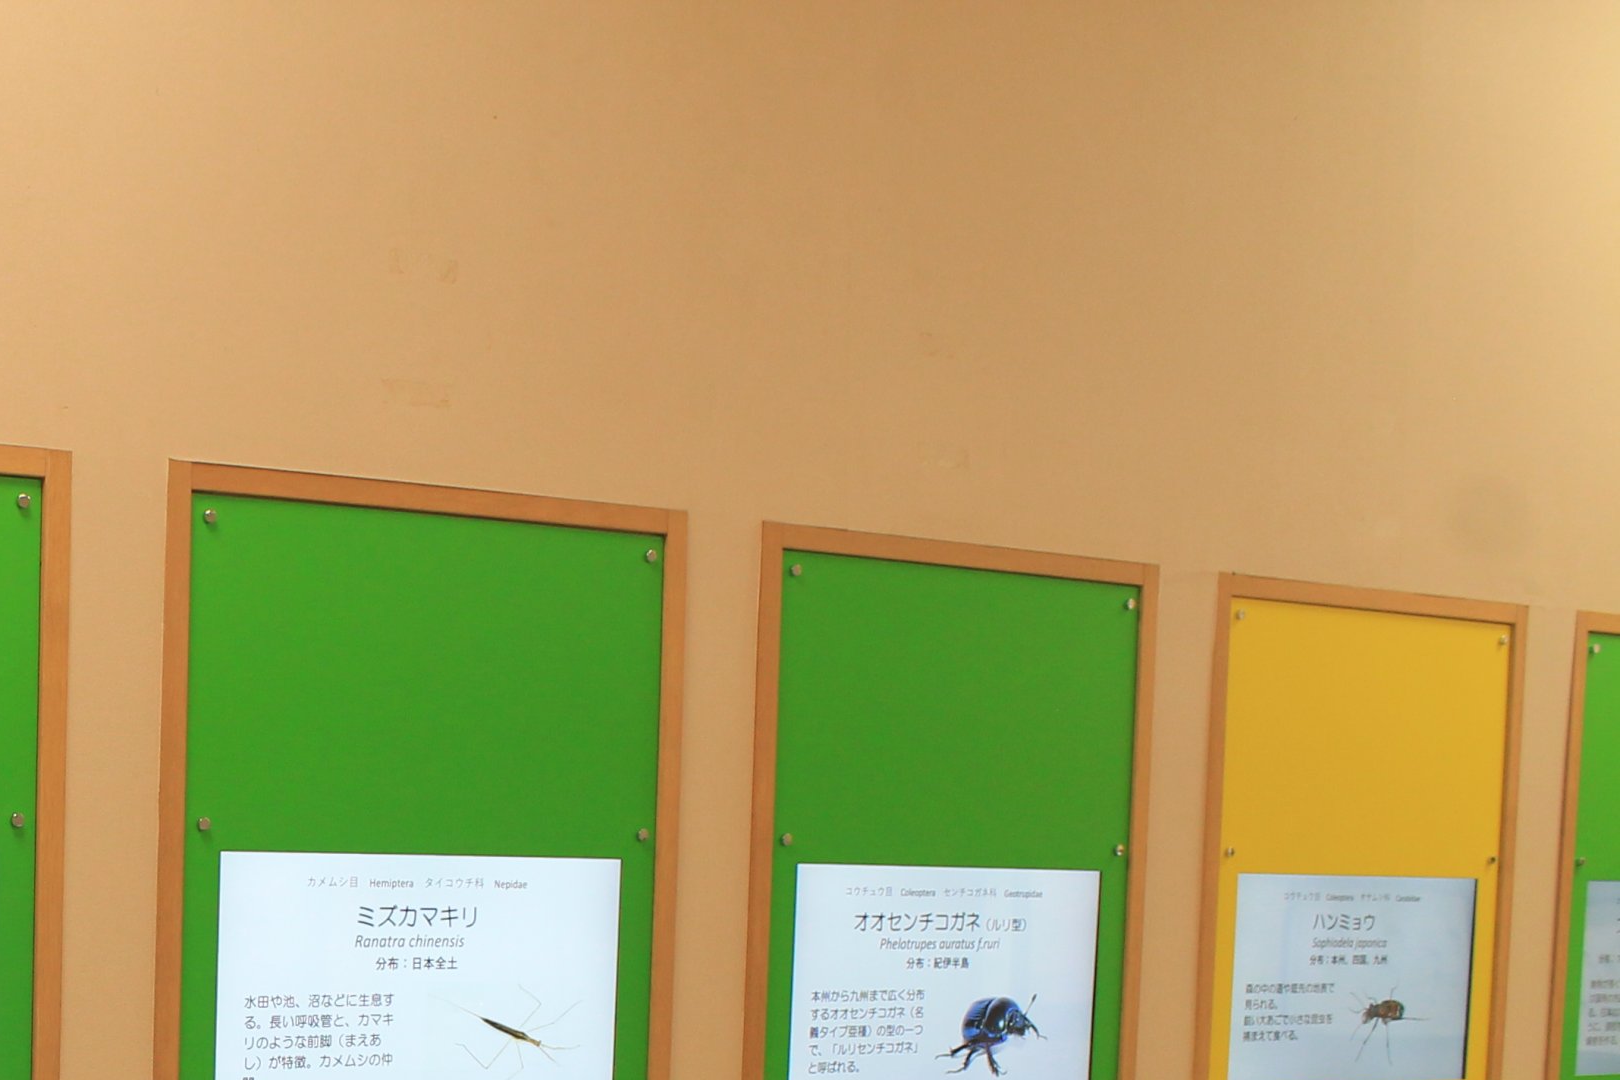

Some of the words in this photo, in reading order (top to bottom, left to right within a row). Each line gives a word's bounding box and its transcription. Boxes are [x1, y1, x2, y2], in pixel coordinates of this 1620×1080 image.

[307, 876, 358, 888] カメムシ目
[370, 878, 414, 889] Hemiptera
[425, 877, 484, 889] タイコウチ科
[494, 879, 528, 890] Nepidae
[901, 889, 936, 898] Coleoptera
[357, 905, 478, 928] ミズカマキリ
[1313, 914, 1376, 930] ハンミョウ
[355, 935, 405, 948] Ranatra
[409, 935, 465, 948] chinensis
[880, 938, 937, 951] Phelotrupes
[939, 939, 975, 949] auratus
[376, 957, 458, 970] 分布：日本全土
[906, 958, 969, 969] 分布：紀伊半島
[244, 993, 394, 1009] 水田や池、沼などに生息す
[811, 990, 925, 1003] 本州から九州まで広く分布
[244, 1013, 394, 1029] る。長い呼吸管と、カマキ
[244, 1034, 381, 1050] リのような前脚（まえあ
[244, 1053, 393, 1071] し）が特徴。カメムシの仲
